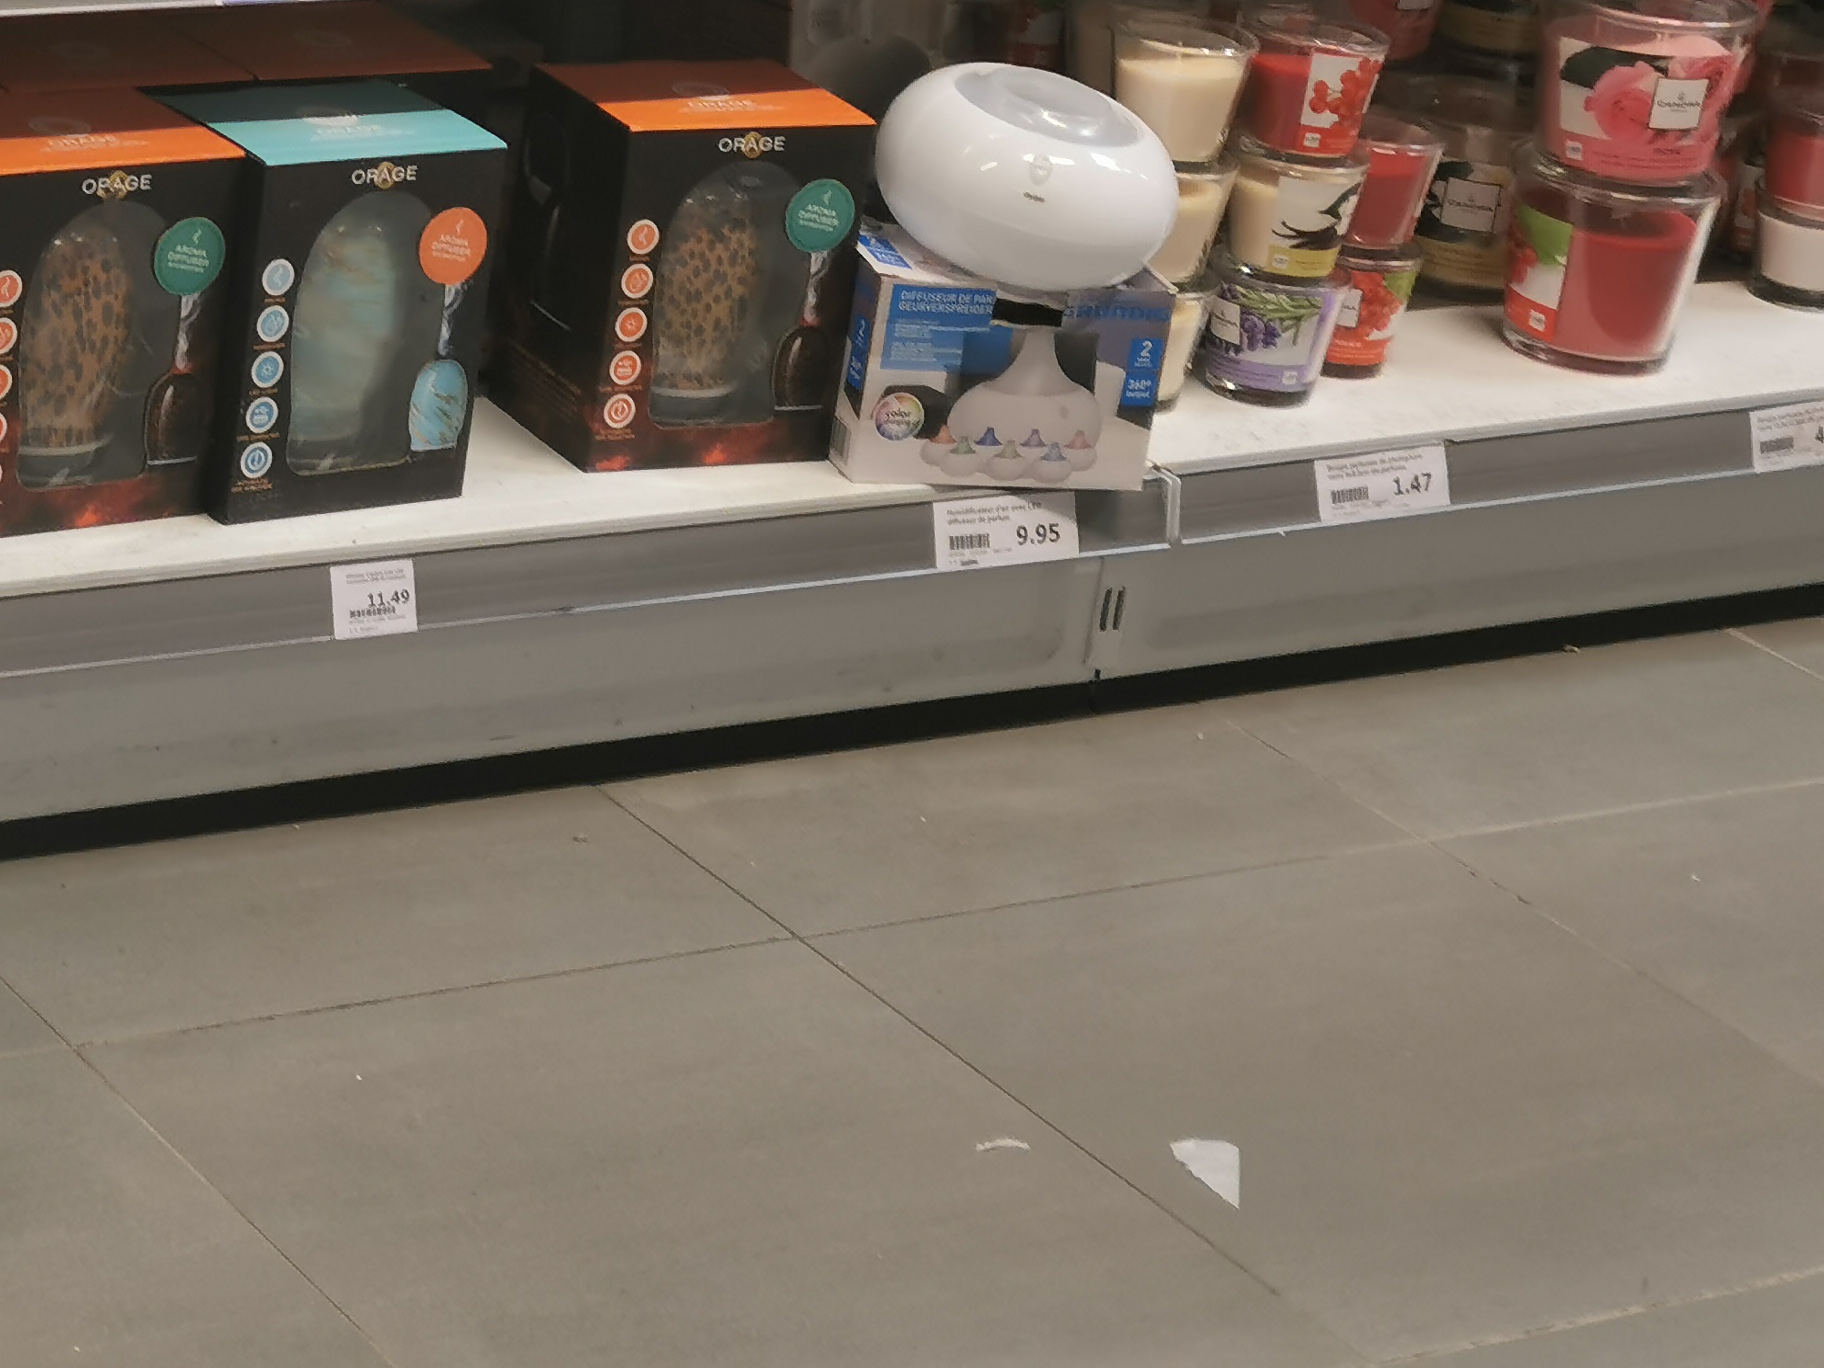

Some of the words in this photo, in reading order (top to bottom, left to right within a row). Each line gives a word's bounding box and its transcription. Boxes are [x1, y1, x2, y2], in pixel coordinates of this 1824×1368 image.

[717, 135, 786, 153] ORAGE
[351, 164, 418, 185] ORAGE
[81, 173, 152, 196] ORAGE
[176, 244, 207, 258] AROMA
[901, 290, 956, 303] DIFFUSEUR
[959, 293, 972, 303] DE
[1139, 340, 1153, 358] 2
[1393, 472, 1432, 495] 1.47
[1016, 522, 1060, 545] 9.95
[367, 589, 410, 608] 11.49
